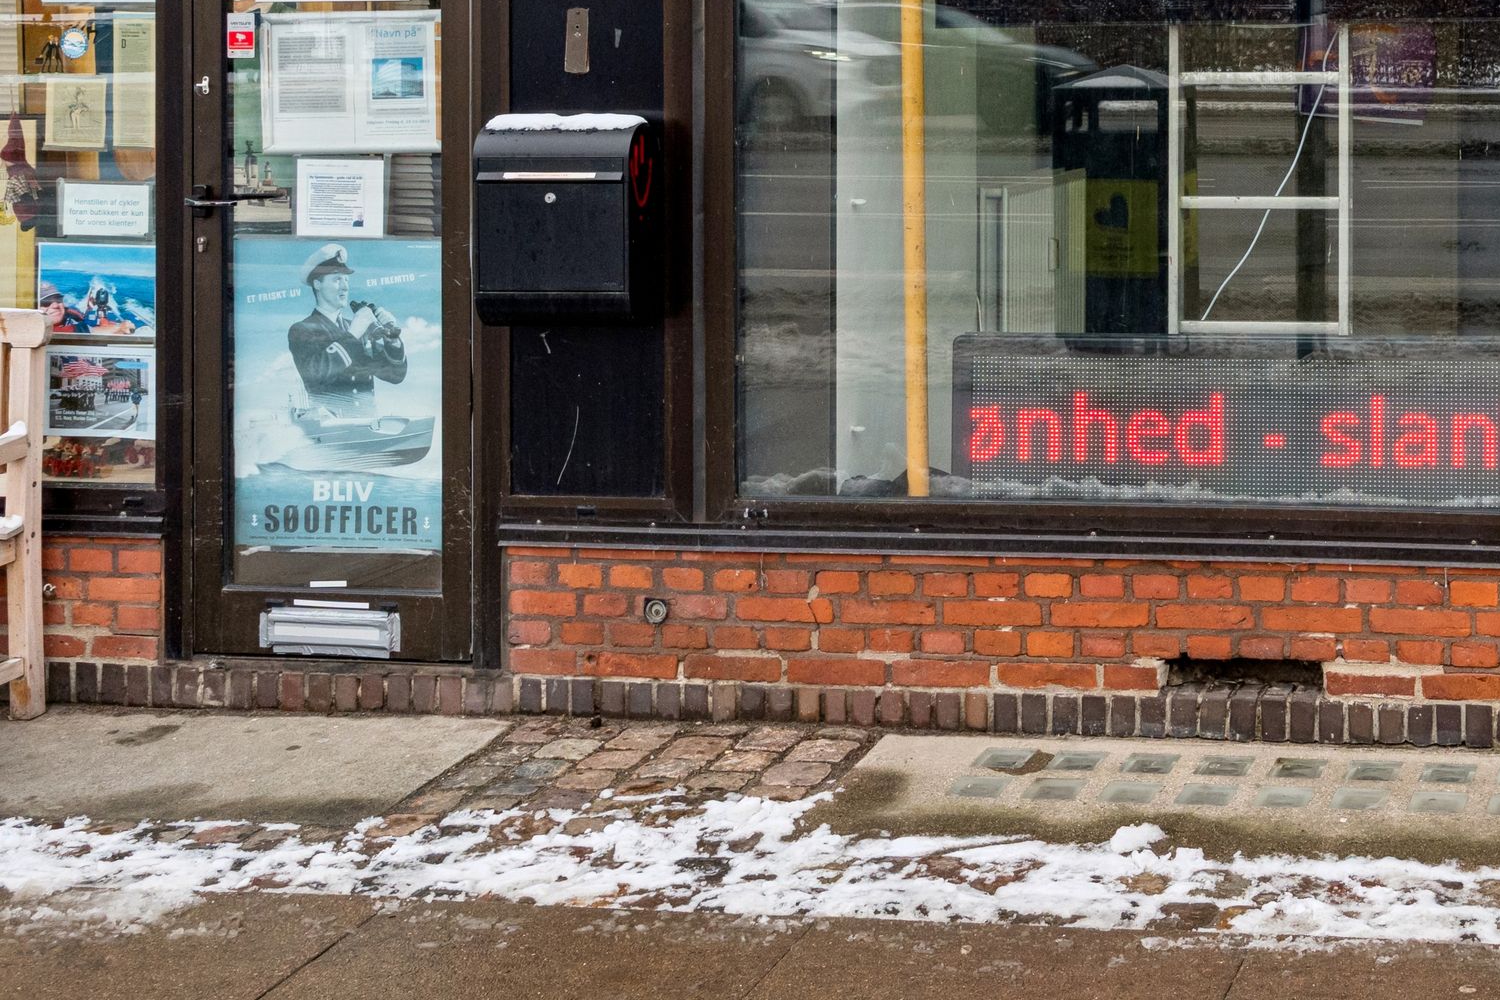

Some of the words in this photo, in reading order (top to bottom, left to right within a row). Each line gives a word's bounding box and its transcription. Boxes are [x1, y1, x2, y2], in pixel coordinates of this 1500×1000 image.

[74, 198, 109, 206] Henstillen
[110, 198, 117, 206] af
[118, 199, 140, 207] cykler
[69, 208, 88, 216] foran
[90, 208, 120, 216] butikken
[246, 294, 256, 304] ET
[258, 290, 288, 302] FRISKT
[313, 479, 375, 502] BLIV
[264, 504, 418, 535] SØOFFICER
